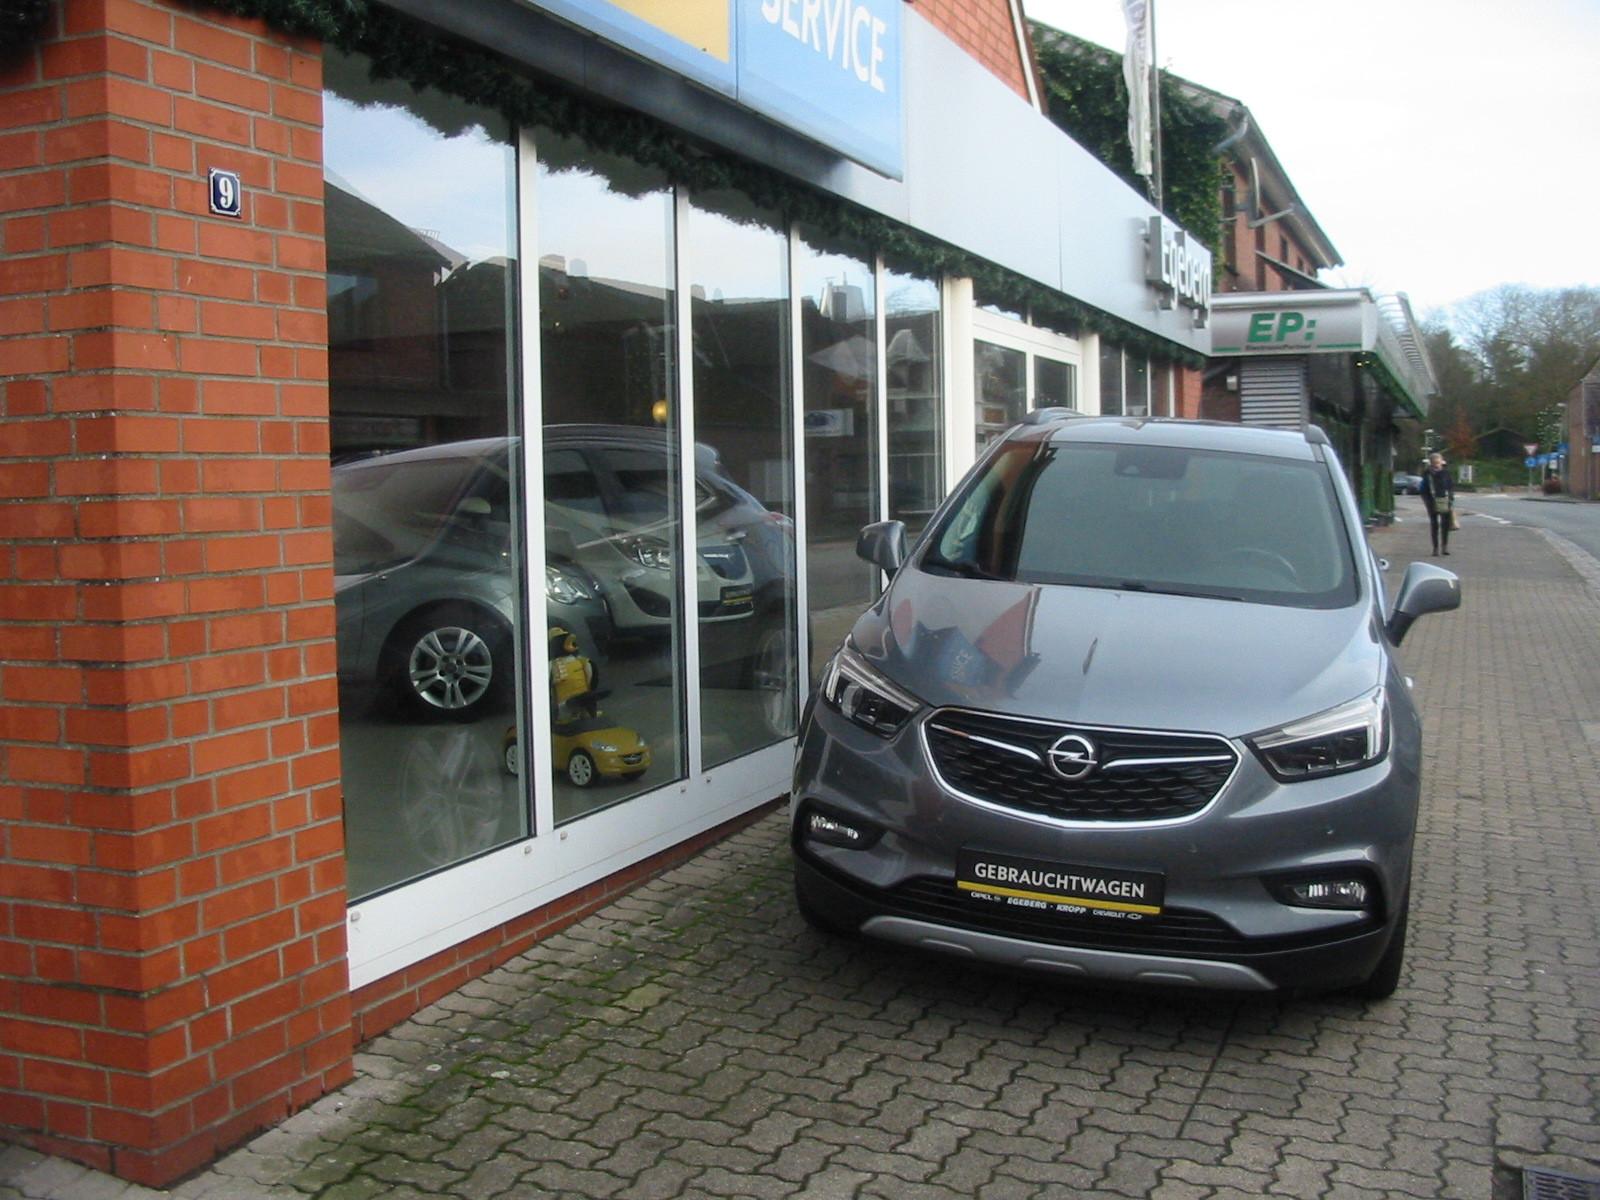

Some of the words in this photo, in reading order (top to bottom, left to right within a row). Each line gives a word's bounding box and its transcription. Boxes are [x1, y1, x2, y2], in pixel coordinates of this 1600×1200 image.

[761, 0, 886, 93] RVICE
[219, 177, 234, 209] 9
[974, 862, 1145, 898] GEBRAUCHTWAGEN
[1007, 897, 1047, 909] EGEBERG
